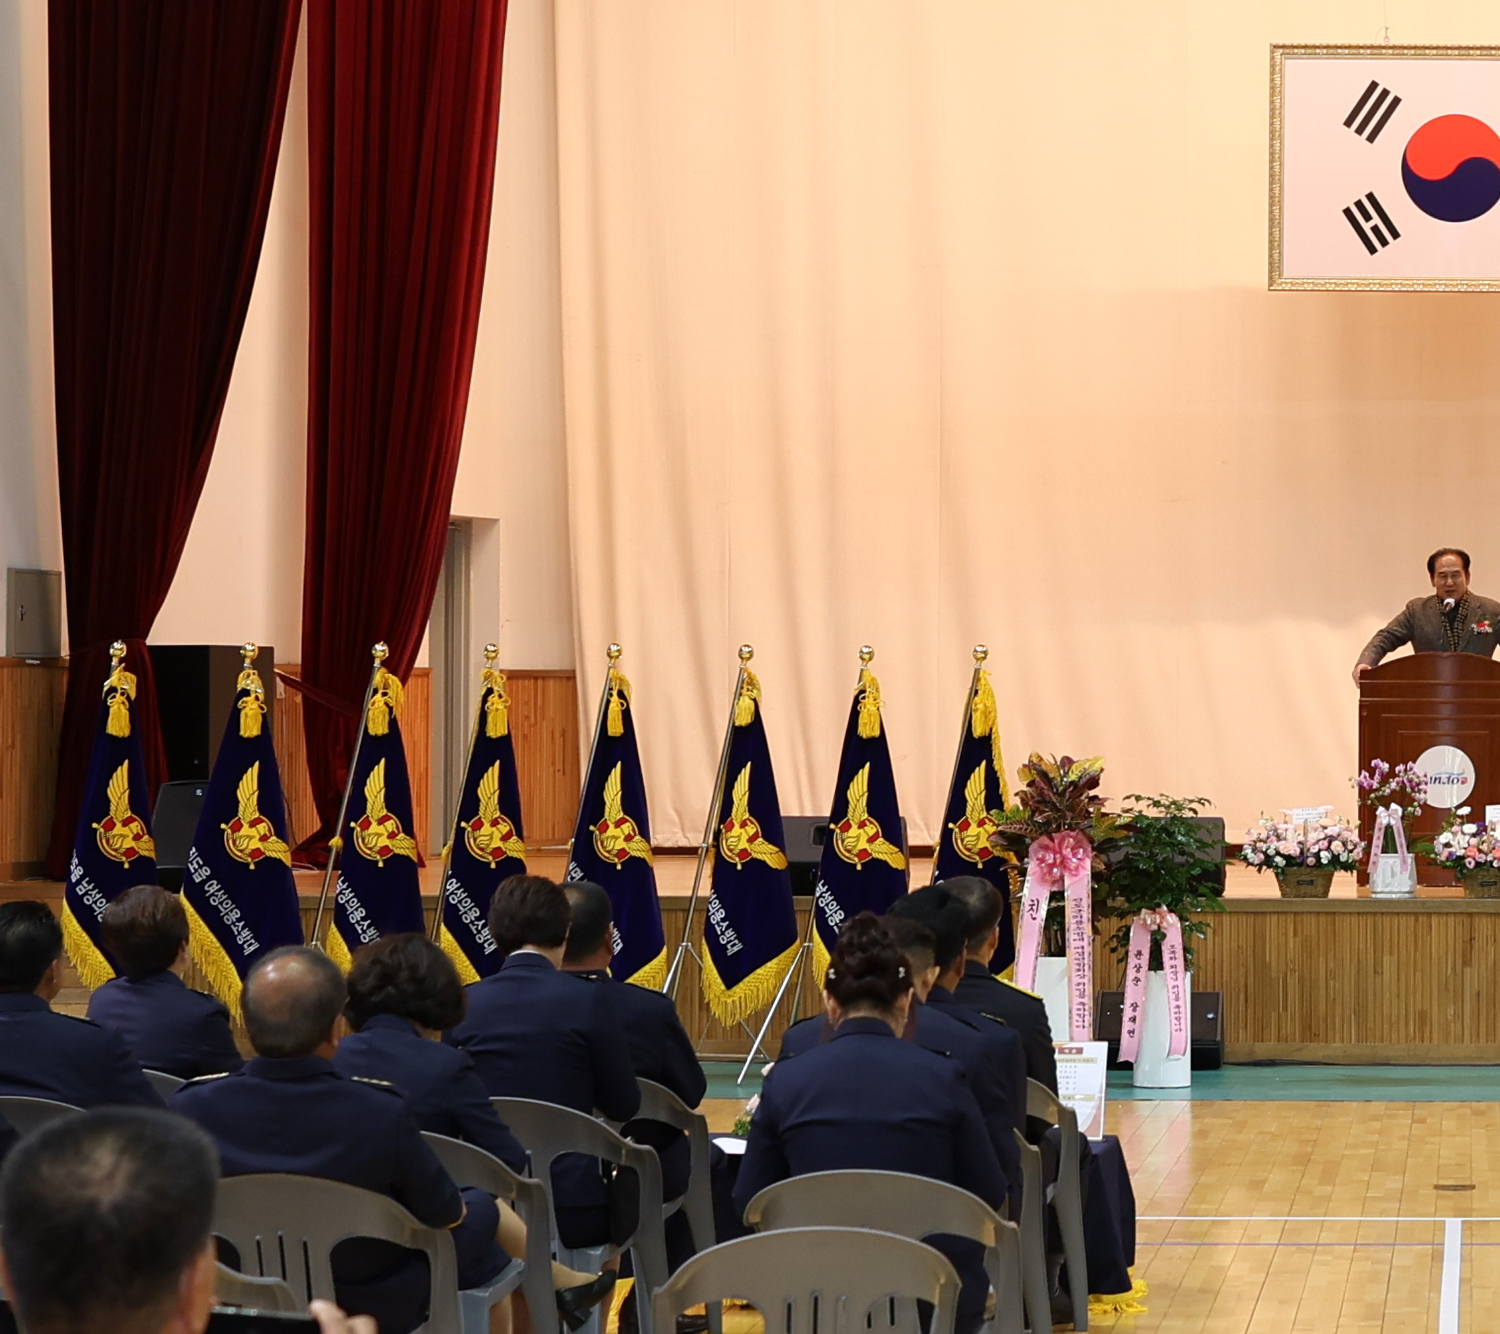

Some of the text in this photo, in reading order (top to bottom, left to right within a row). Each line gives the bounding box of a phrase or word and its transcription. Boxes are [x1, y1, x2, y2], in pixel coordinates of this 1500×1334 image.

[204, 879, 260, 956] 여성의용소방대
[336, 876, 382, 945] 남성의용소방
[446, 878, 498, 955] 여성의용소방대
[1027, 898, 1040, 921] 친
